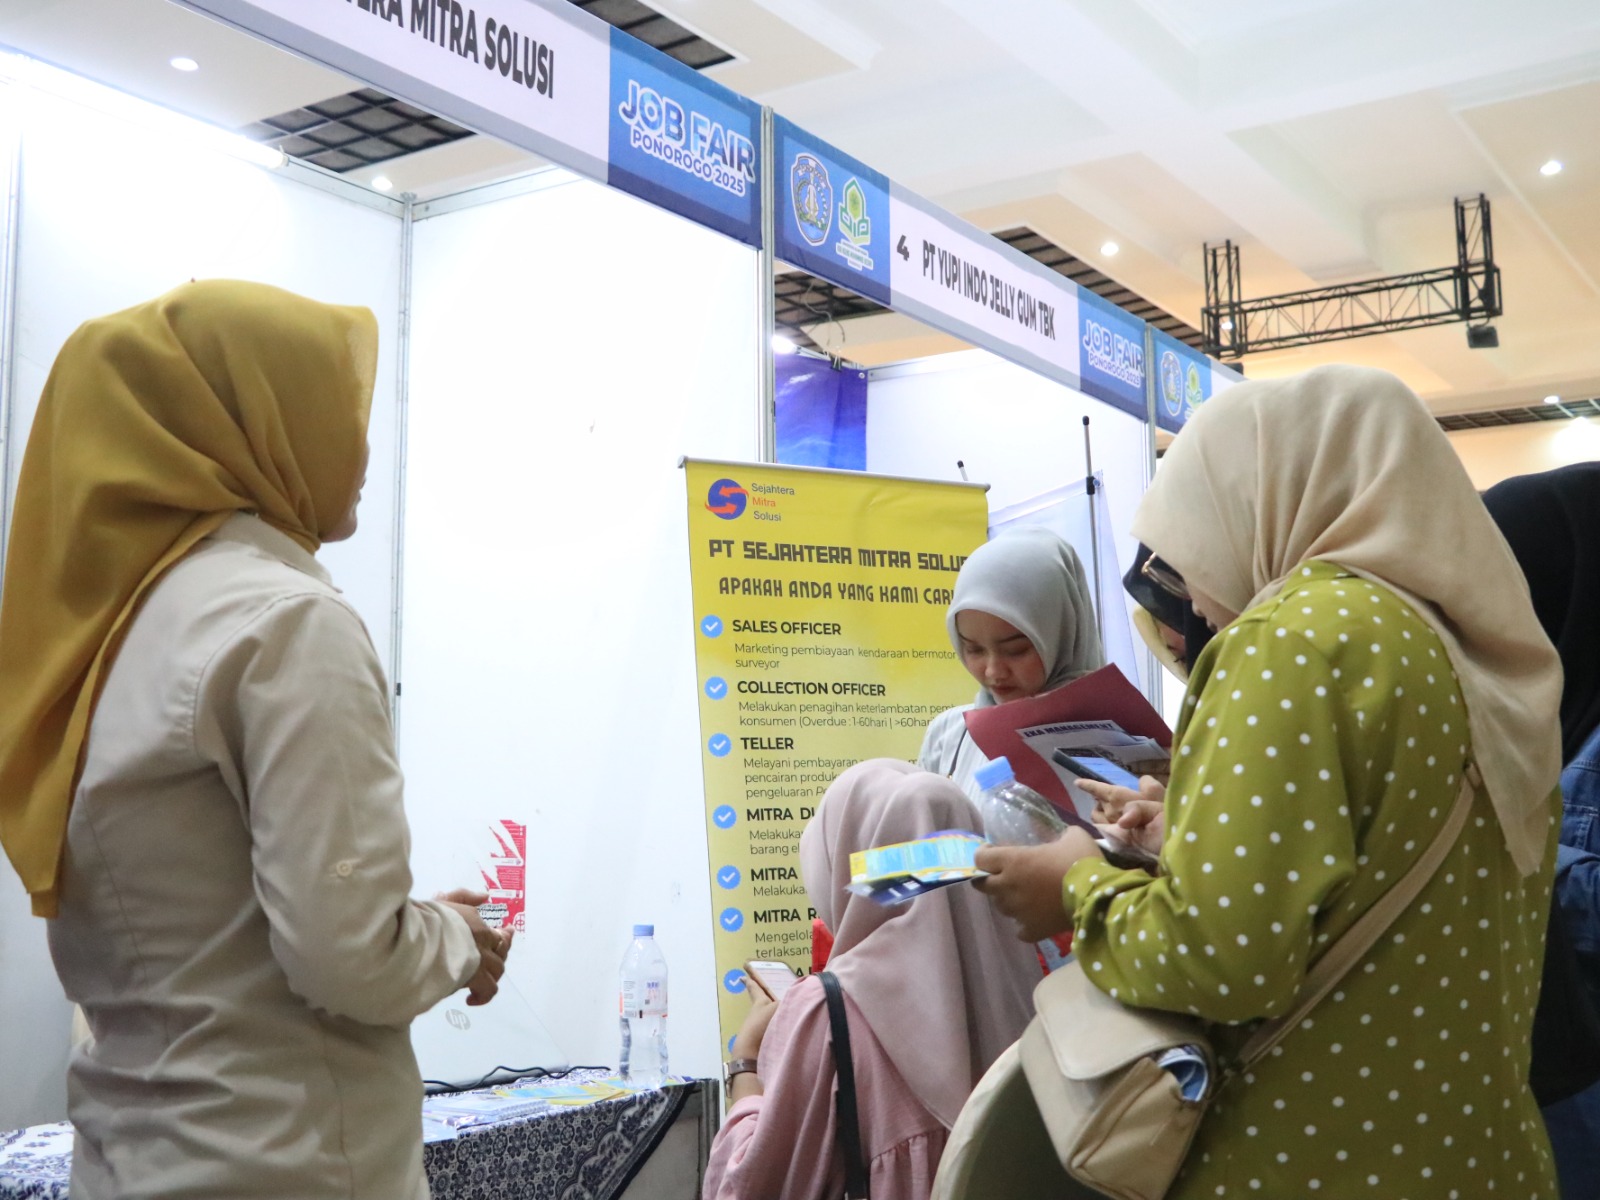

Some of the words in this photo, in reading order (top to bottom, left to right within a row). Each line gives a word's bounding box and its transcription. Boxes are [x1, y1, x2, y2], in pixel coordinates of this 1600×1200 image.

[410, 0, 479, 64] MITRA
[484, 17, 554, 99] SOLUSI
[620, 80, 685, 146] JOB
[691, 111, 755, 183] FAIR
[632, 128, 712, 180] PONOROGO
[714, 167, 744, 195] 2025
[896, 235, 910, 262] 4
[922, 239, 936, 281] PT
[937, 247, 961, 294] YUPI
[963, 261, 988, 307] INDO
[989, 274, 1016, 320] JELLY
[1017, 289, 1037, 332] GUM
[1038, 300, 1056, 341] TBK
[1083, 320, 1112, 361] JOB
[1114, 334, 1145, 377] FAIR
[751, 482, 795, 496] Sejahtera
[752, 496, 776, 507] Mitra
[753, 510, 782, 522] Solusi
[708, 539, 735, 558] PT
[742, 540, 853, 565] SEJAHTERA
[857, 548, 912, 569] MITRA
[917, 552, 968, 572] SOLU
[719, 577, 783, 598] APAKAH
[788, 580, 833, 600] ANDA
[837, 581, 875, 603] YANG
[879, 585, 919, 604] KAMI
[732, 619, 778, 634] SALES
[780, 621, 842, 636] OFFICER
[734, 643, 789, 657] Marketing
[790, 645, 855, 659] pembiayaan
[857, 647, 910, 659] kendaraan
[735, 659, 781, 671] surveyor
[737, 680, 829, 696] COLLECTION
[831, 682, 887, 697] OFFICER
[738, 701, 797, 713] Melakukan
[799, 701, 854, 715] penagihan
[855, 702, 928, 714] keterlambatan
[739, 716, 797, 727] konsumen
[1023, 729, 1045, 738] EKA
[740, 736, 794, 750] TELLER
[743, 757, 791, 770] Melayani
[744, 772, 798, 785] pencairan
[745, 787, 813, 800] pengeluaran
[746, 808, 794, 822] MITRA
[750, 843, 790, 857] barang
[750, 867, 798, 882] MITRA
[753, 884, 808, 898] Melakuka
[753, 908, 802, 924] MITRA
